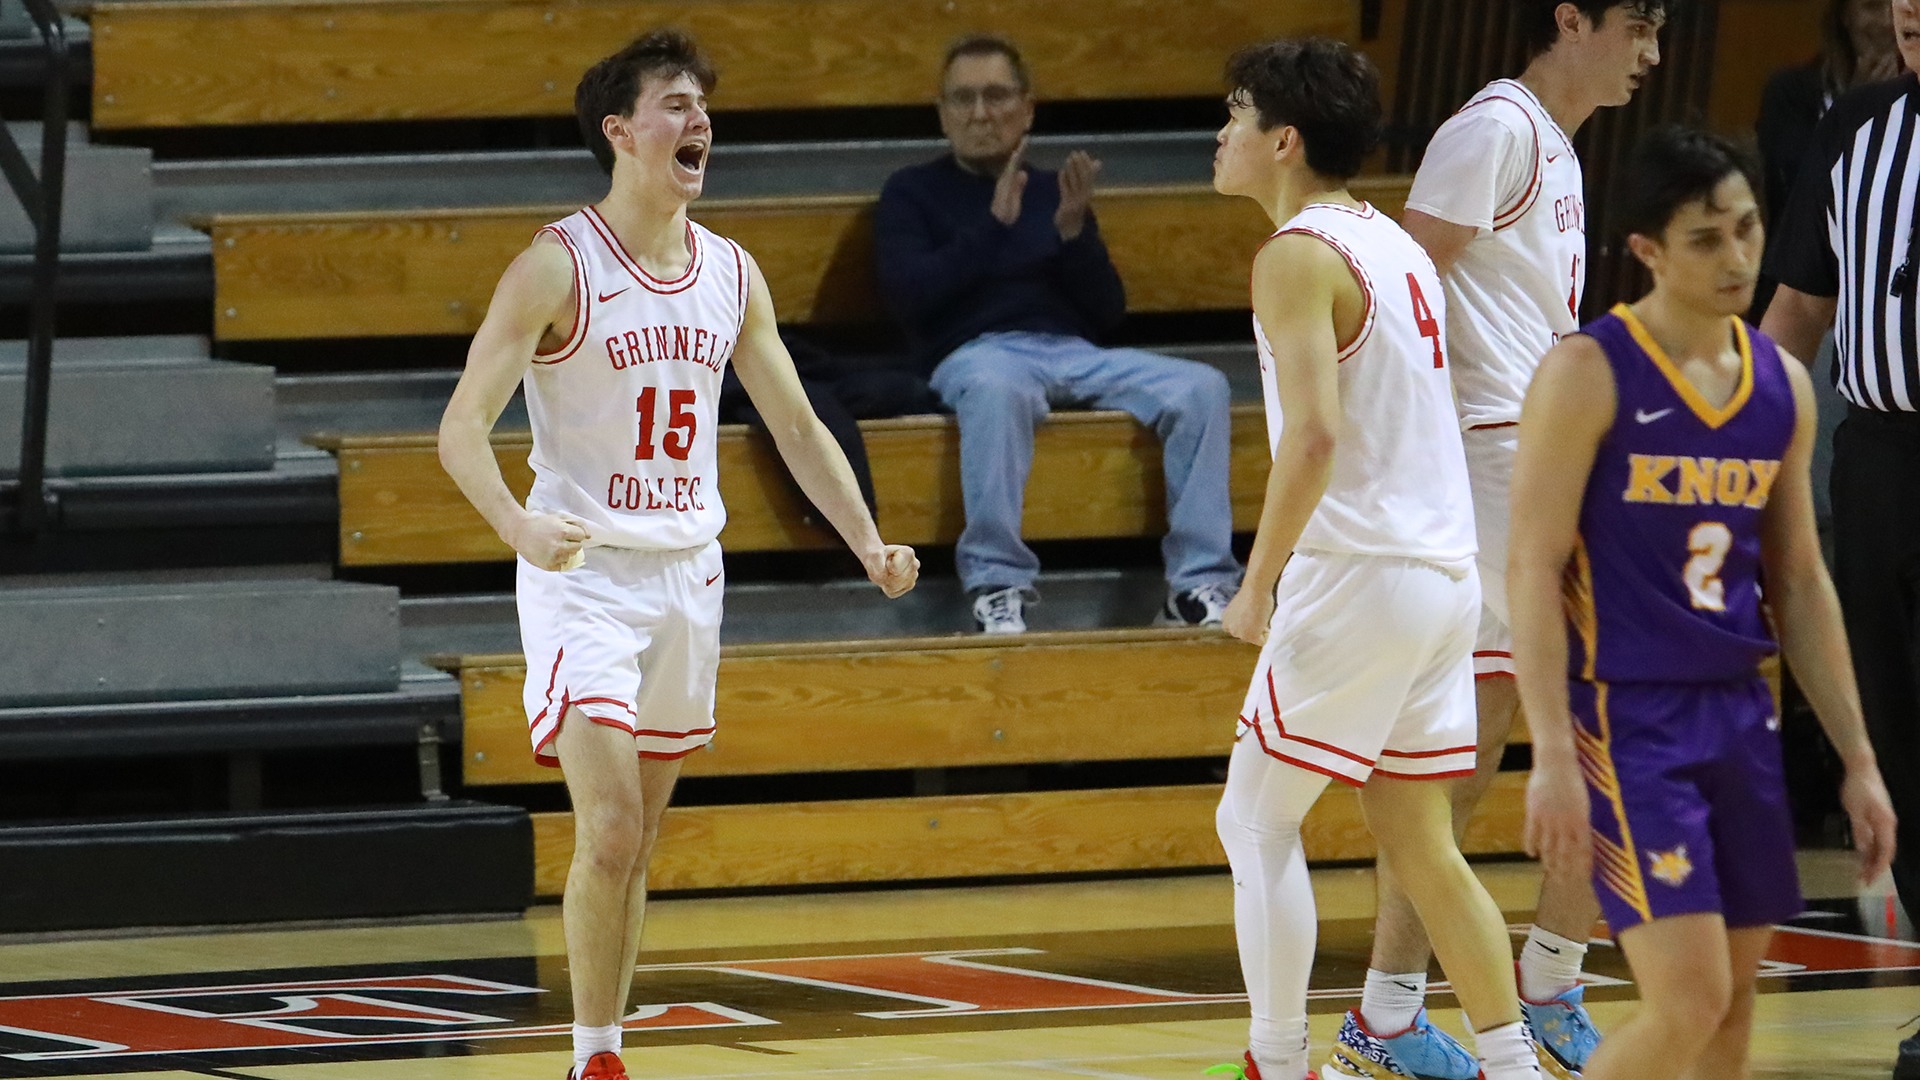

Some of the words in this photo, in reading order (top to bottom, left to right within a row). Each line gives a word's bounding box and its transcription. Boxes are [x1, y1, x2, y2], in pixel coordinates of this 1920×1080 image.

[1405, 272, 1444, 369] 4
[634, 386, 697, 461] 15
[1622, 453, 1782, 510] KNOX
[1682, 520, 1733, 613] 2
